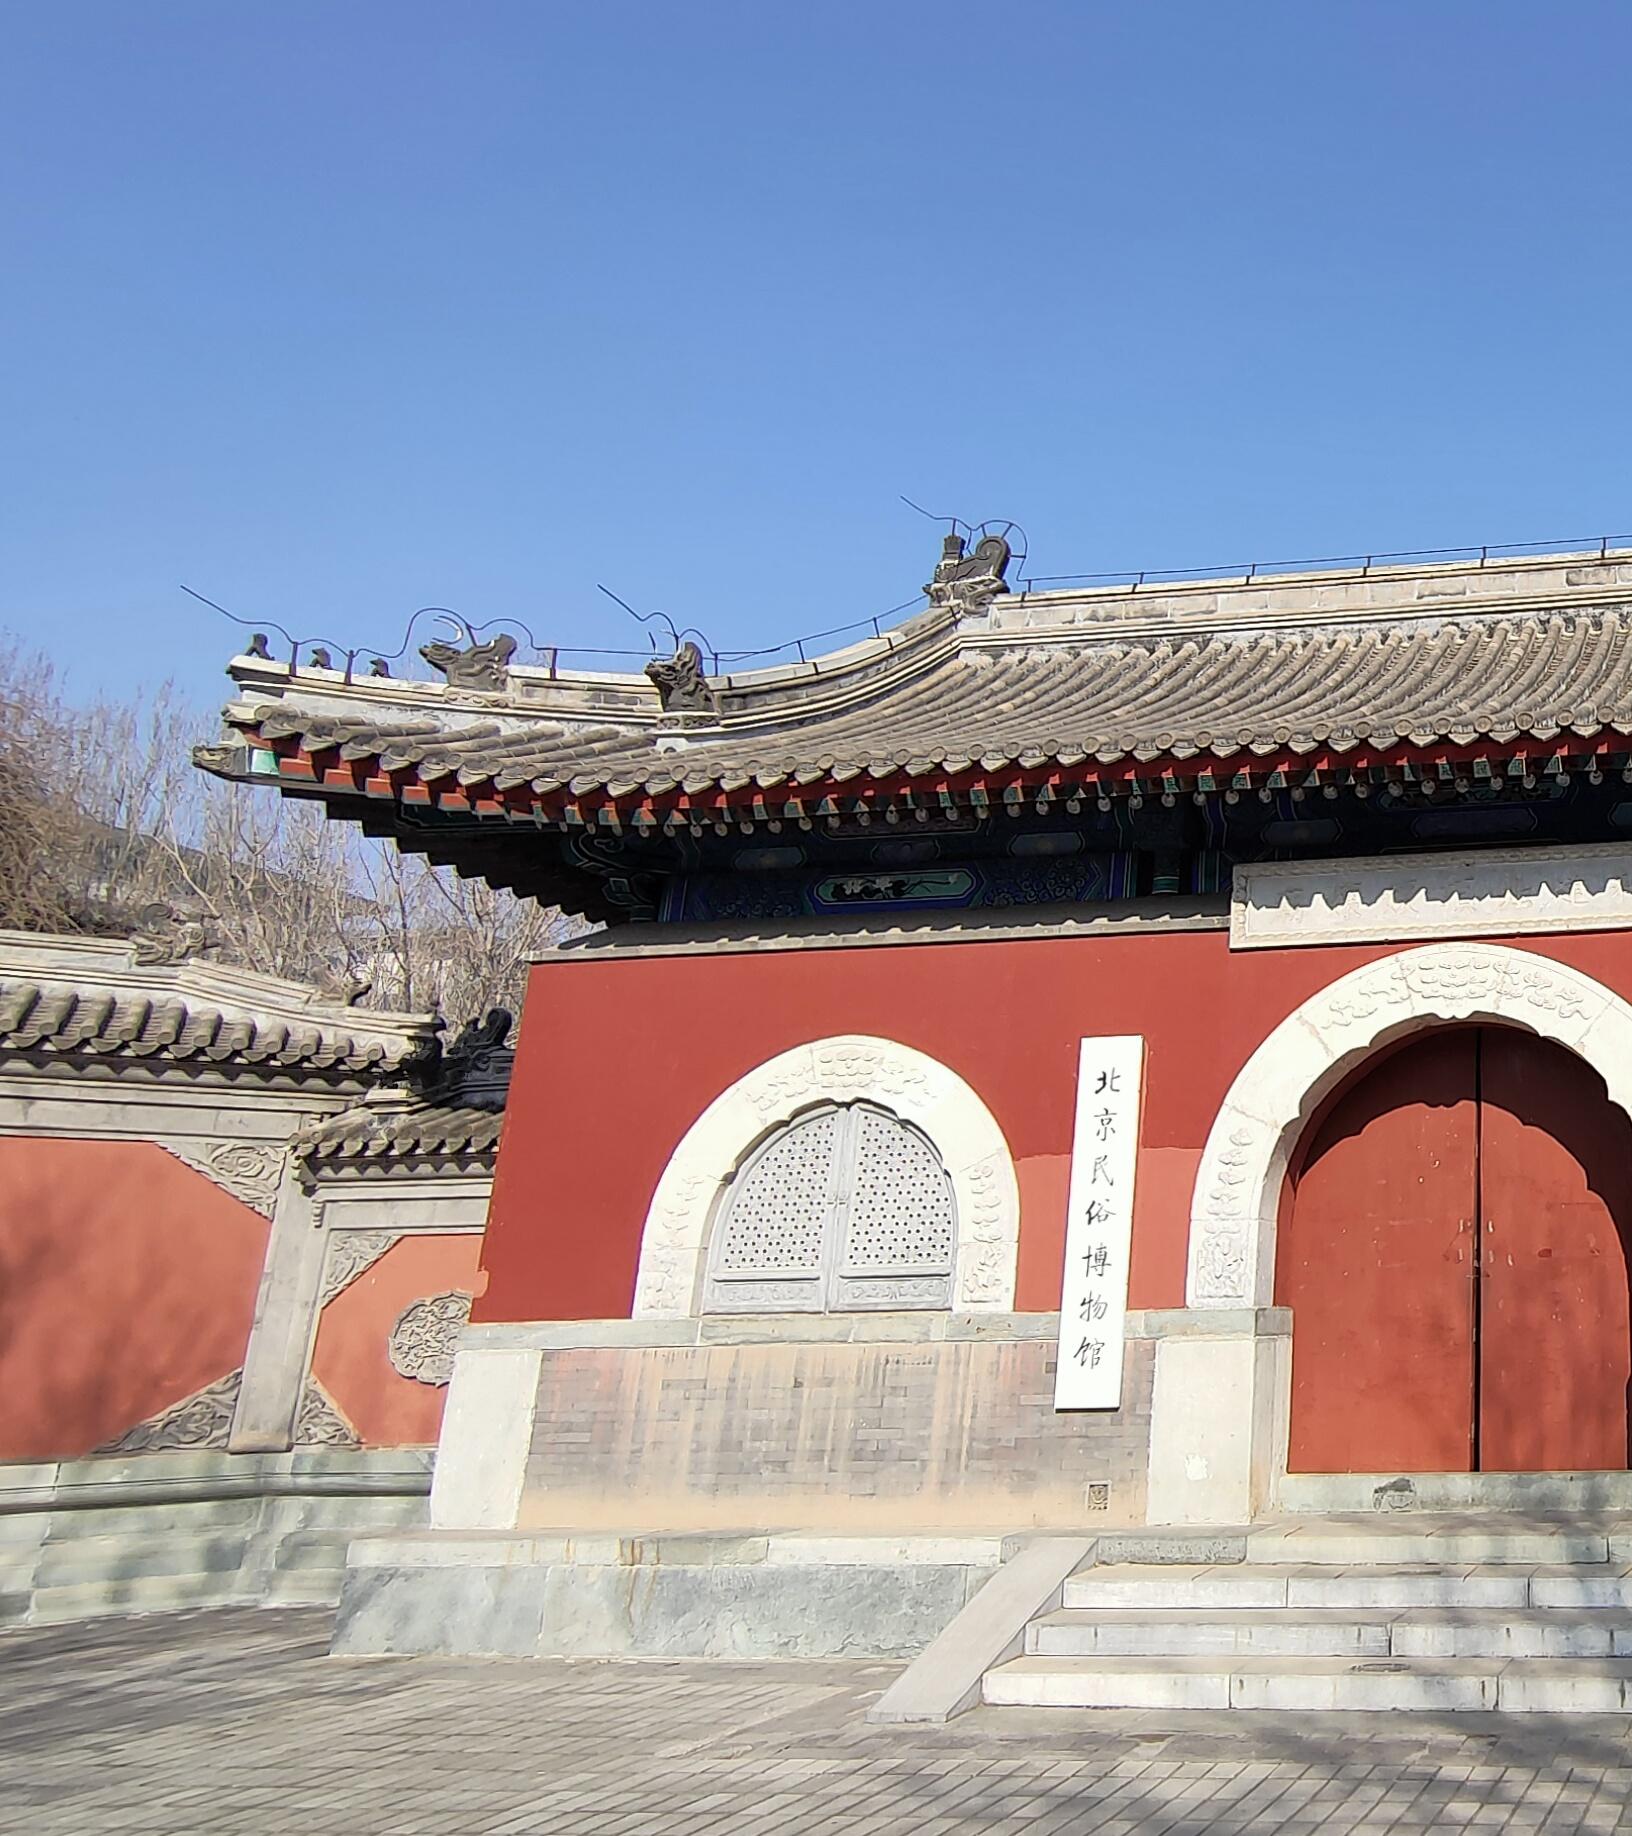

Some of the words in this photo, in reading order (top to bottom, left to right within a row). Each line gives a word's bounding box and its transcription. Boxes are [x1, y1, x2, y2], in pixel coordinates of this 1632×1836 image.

[1074, 1066, 1122, 1370] 北京民俗博物馆
